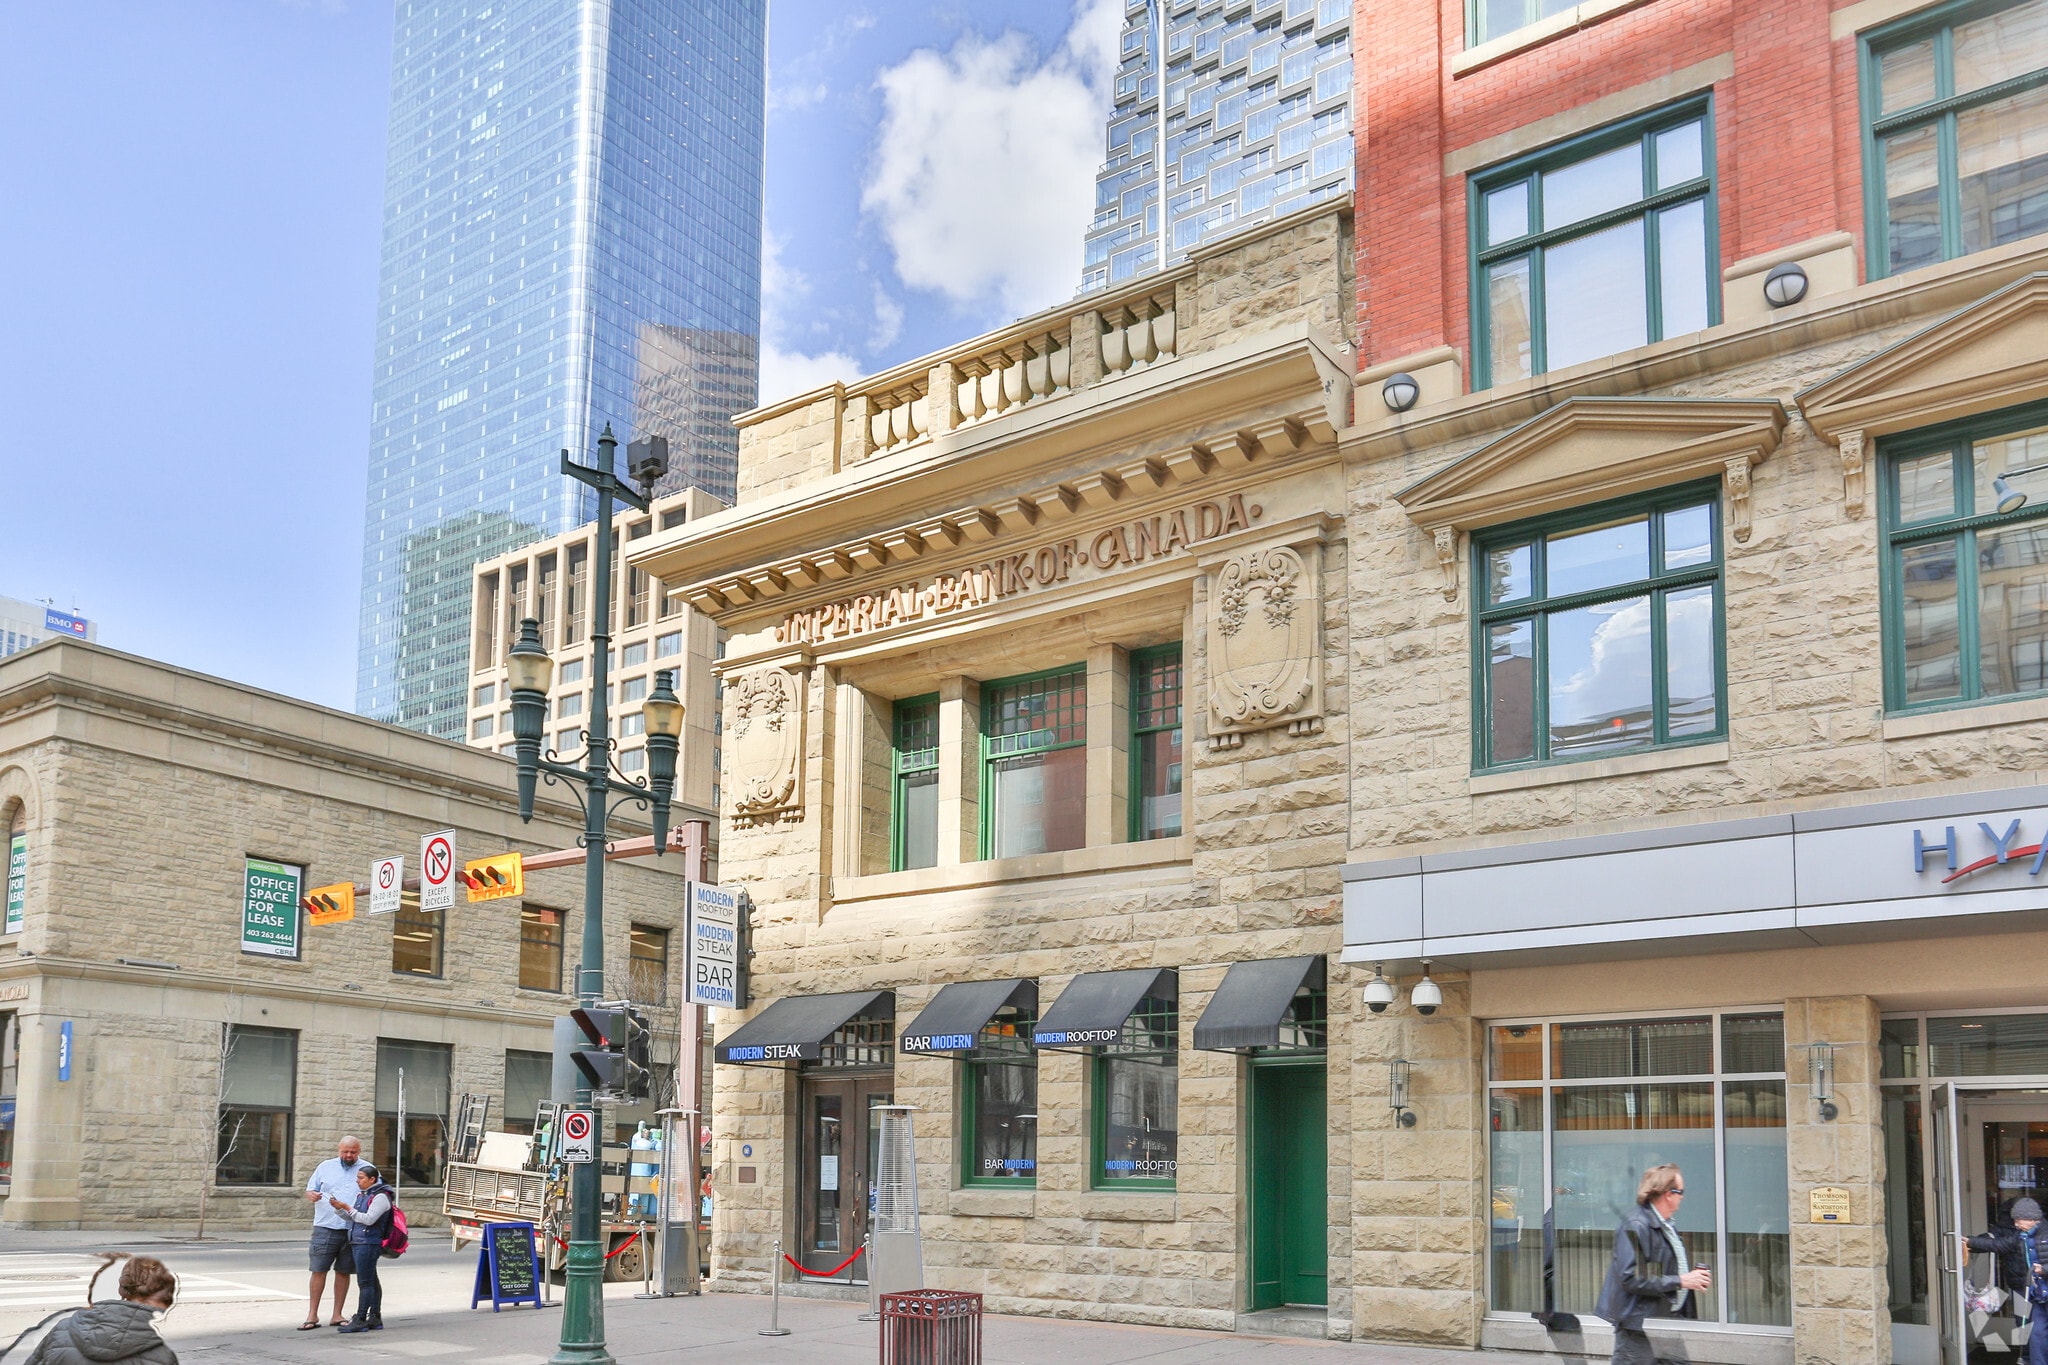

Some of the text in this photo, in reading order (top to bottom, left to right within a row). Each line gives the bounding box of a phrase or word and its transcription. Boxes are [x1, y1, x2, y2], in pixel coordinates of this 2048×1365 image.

[783, 493, 1250, 643] IMPERIAL BANK OF CANADA
[47, 615, 72, 629] BMO
[12, 854, 27, 865] OFFI
[12, 866, 27, 877] SPAC
[11, 879, 23, 890] FOR
[250, 875, 294, 892] OFFICE
[10, 891, 24, 903] LEAS
[249, 888, 289, 904] SPACE
[427, 886, 447, 897] EXCEPT
[697, 888, 733, 908] MODERN
[248, 900, 274, 913] FOR
[425, 896, 450, 907] BICYCLES
[697, 902, 733, 917] ROOFTOP
[247, 912, 285, 927] LEASE
[246, 929, 293, 942] 403 263 4444
[697, 923, 733, 942] MODERN
[274, 948, 294, 956] CBRE
[697, 938, 733, 956] STEAK
[697, 963, 733, 988] BAR
[696, 984, 733, 1002] MODERN
[904, 1034, 972, 1051] BAR MODERN
[1035, 1029, 1117, 1044] MODERN ROOFTOP
[729, 1044, 802, 1060] MODERN STEAK
[984, 1159, 1035, 1169] BAR MODERN
[1105, 1160, 1177, 1171] MODERN ROOFTO
[1812, 1192, 1848, 1200] THOMSONS
